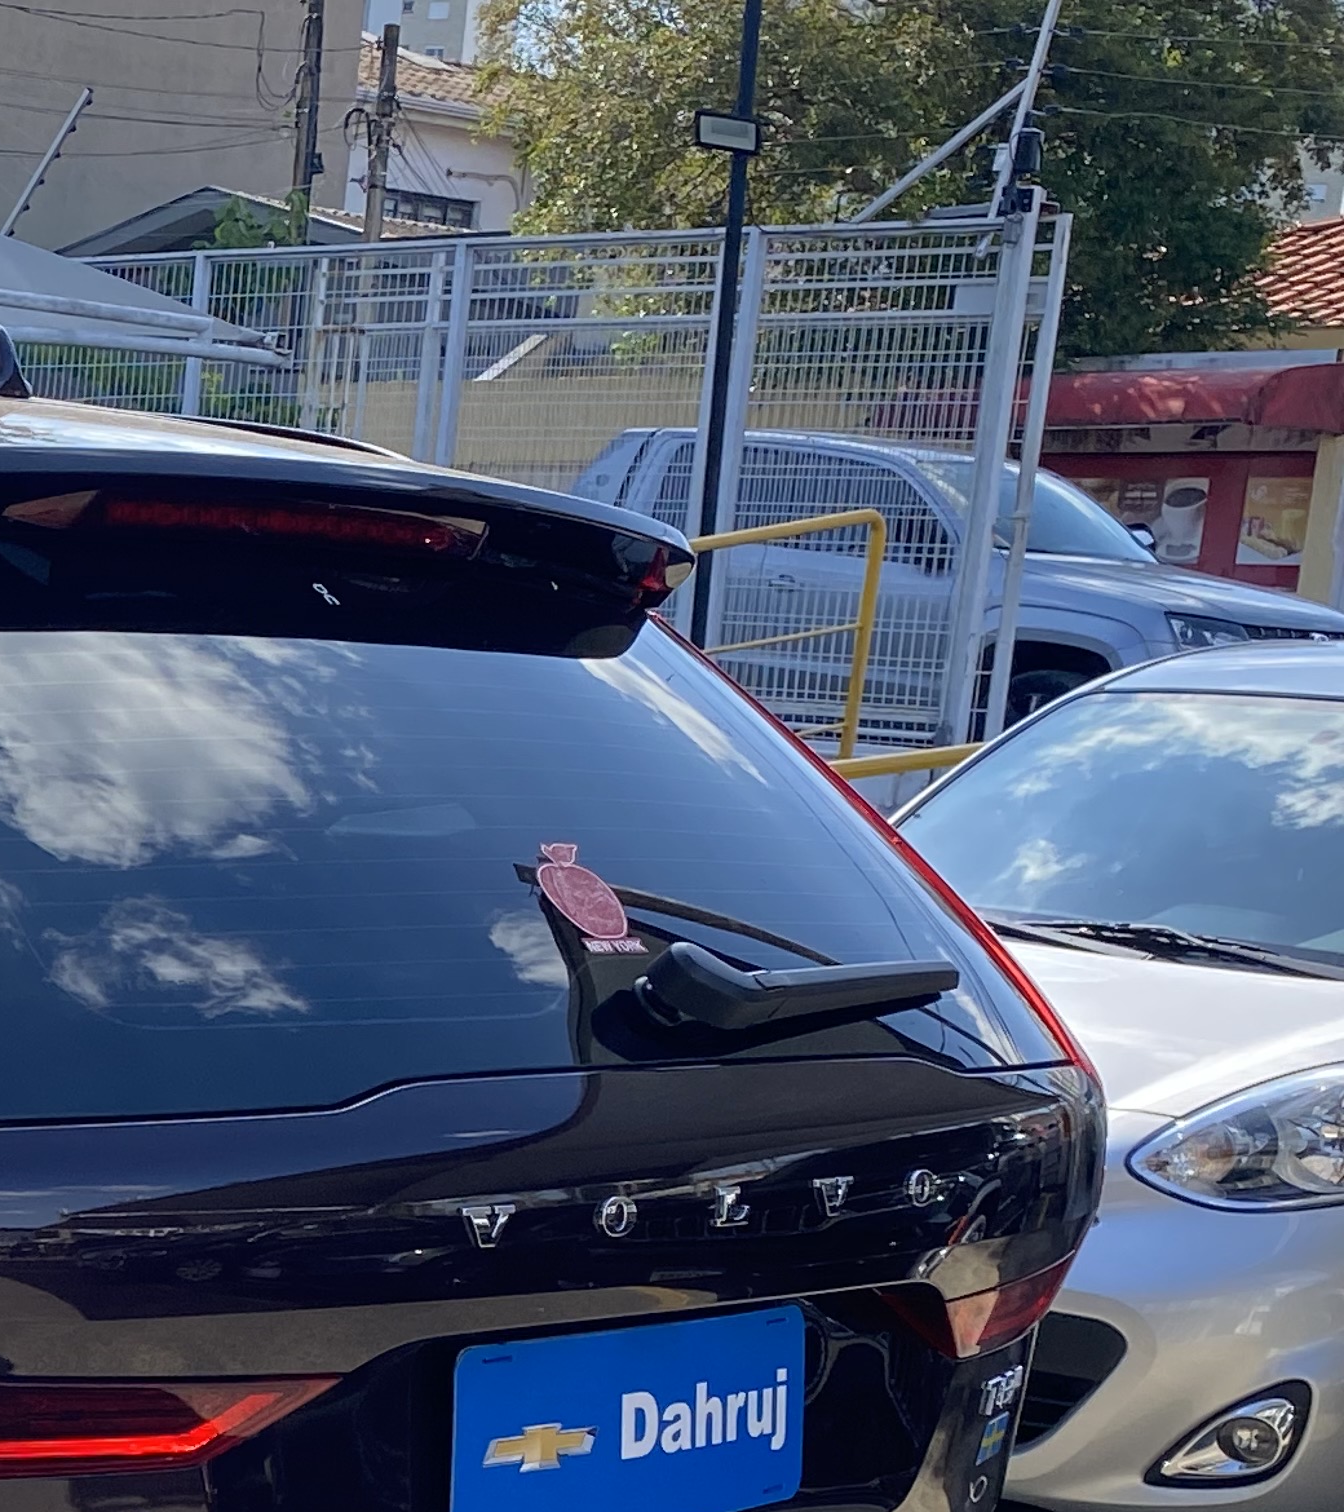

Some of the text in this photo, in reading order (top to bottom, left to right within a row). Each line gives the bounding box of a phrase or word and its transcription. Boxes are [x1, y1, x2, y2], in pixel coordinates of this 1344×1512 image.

[585, 940, 650, 953] NEW YORK
[460, 1168, 935, 1249] VOLVO
[619, 1367, 789, 1462] Dahruj
